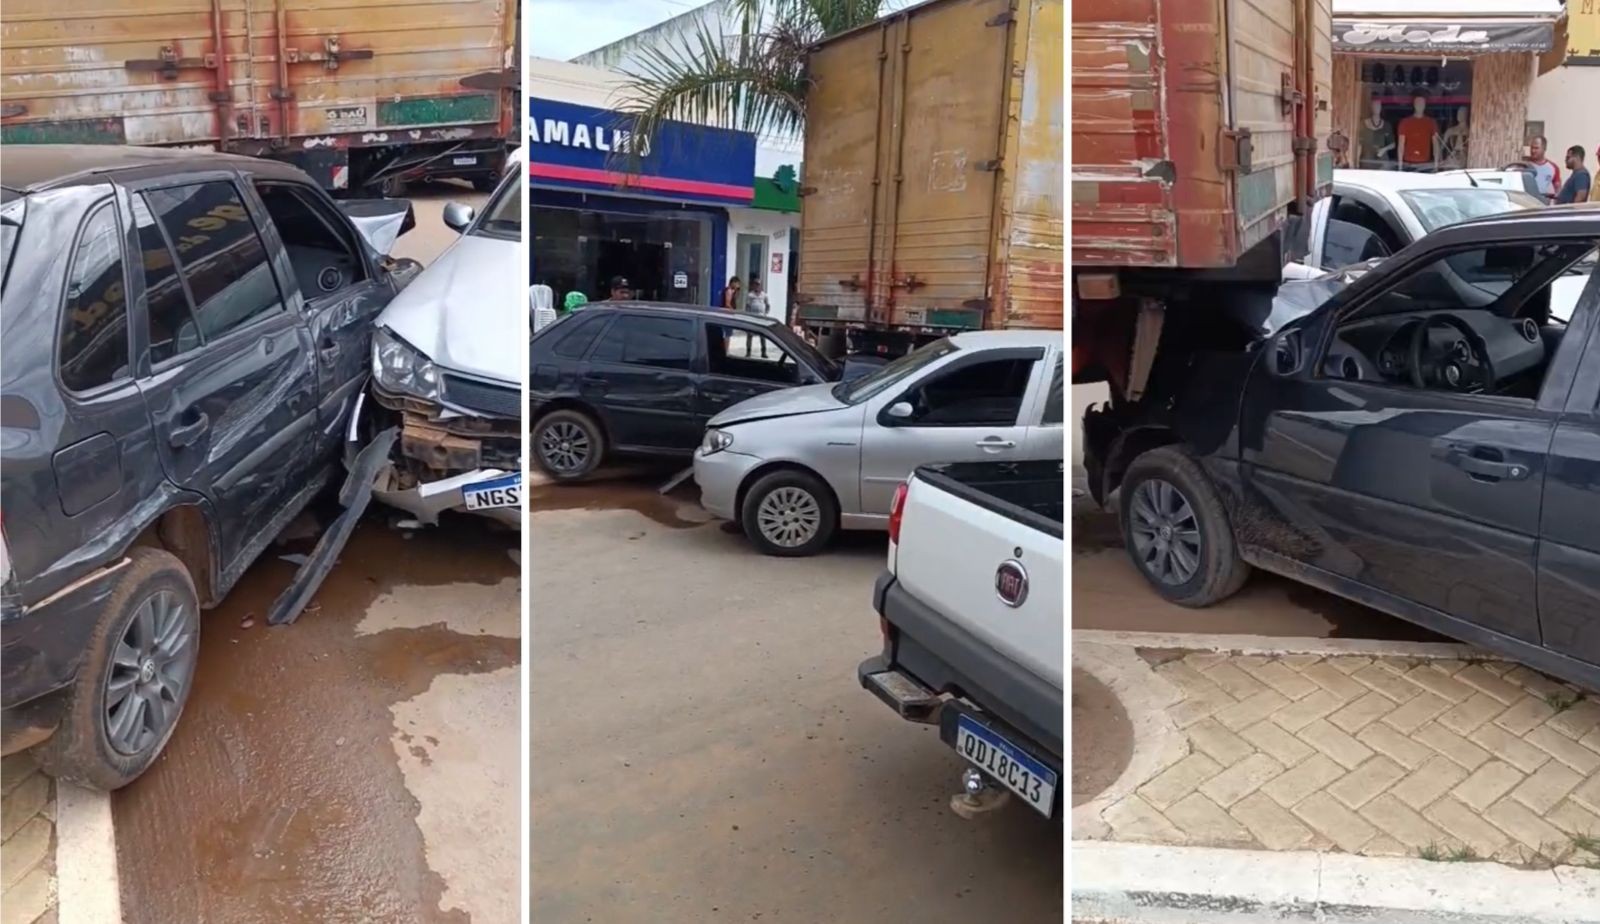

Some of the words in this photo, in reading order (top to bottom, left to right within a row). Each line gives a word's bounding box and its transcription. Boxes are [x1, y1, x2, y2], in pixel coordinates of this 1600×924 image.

[1342, 23, 1490, 45] Moda
[476, 485, 521, 507] NGS
[964, 734, 1043, 803] QDI8C13
